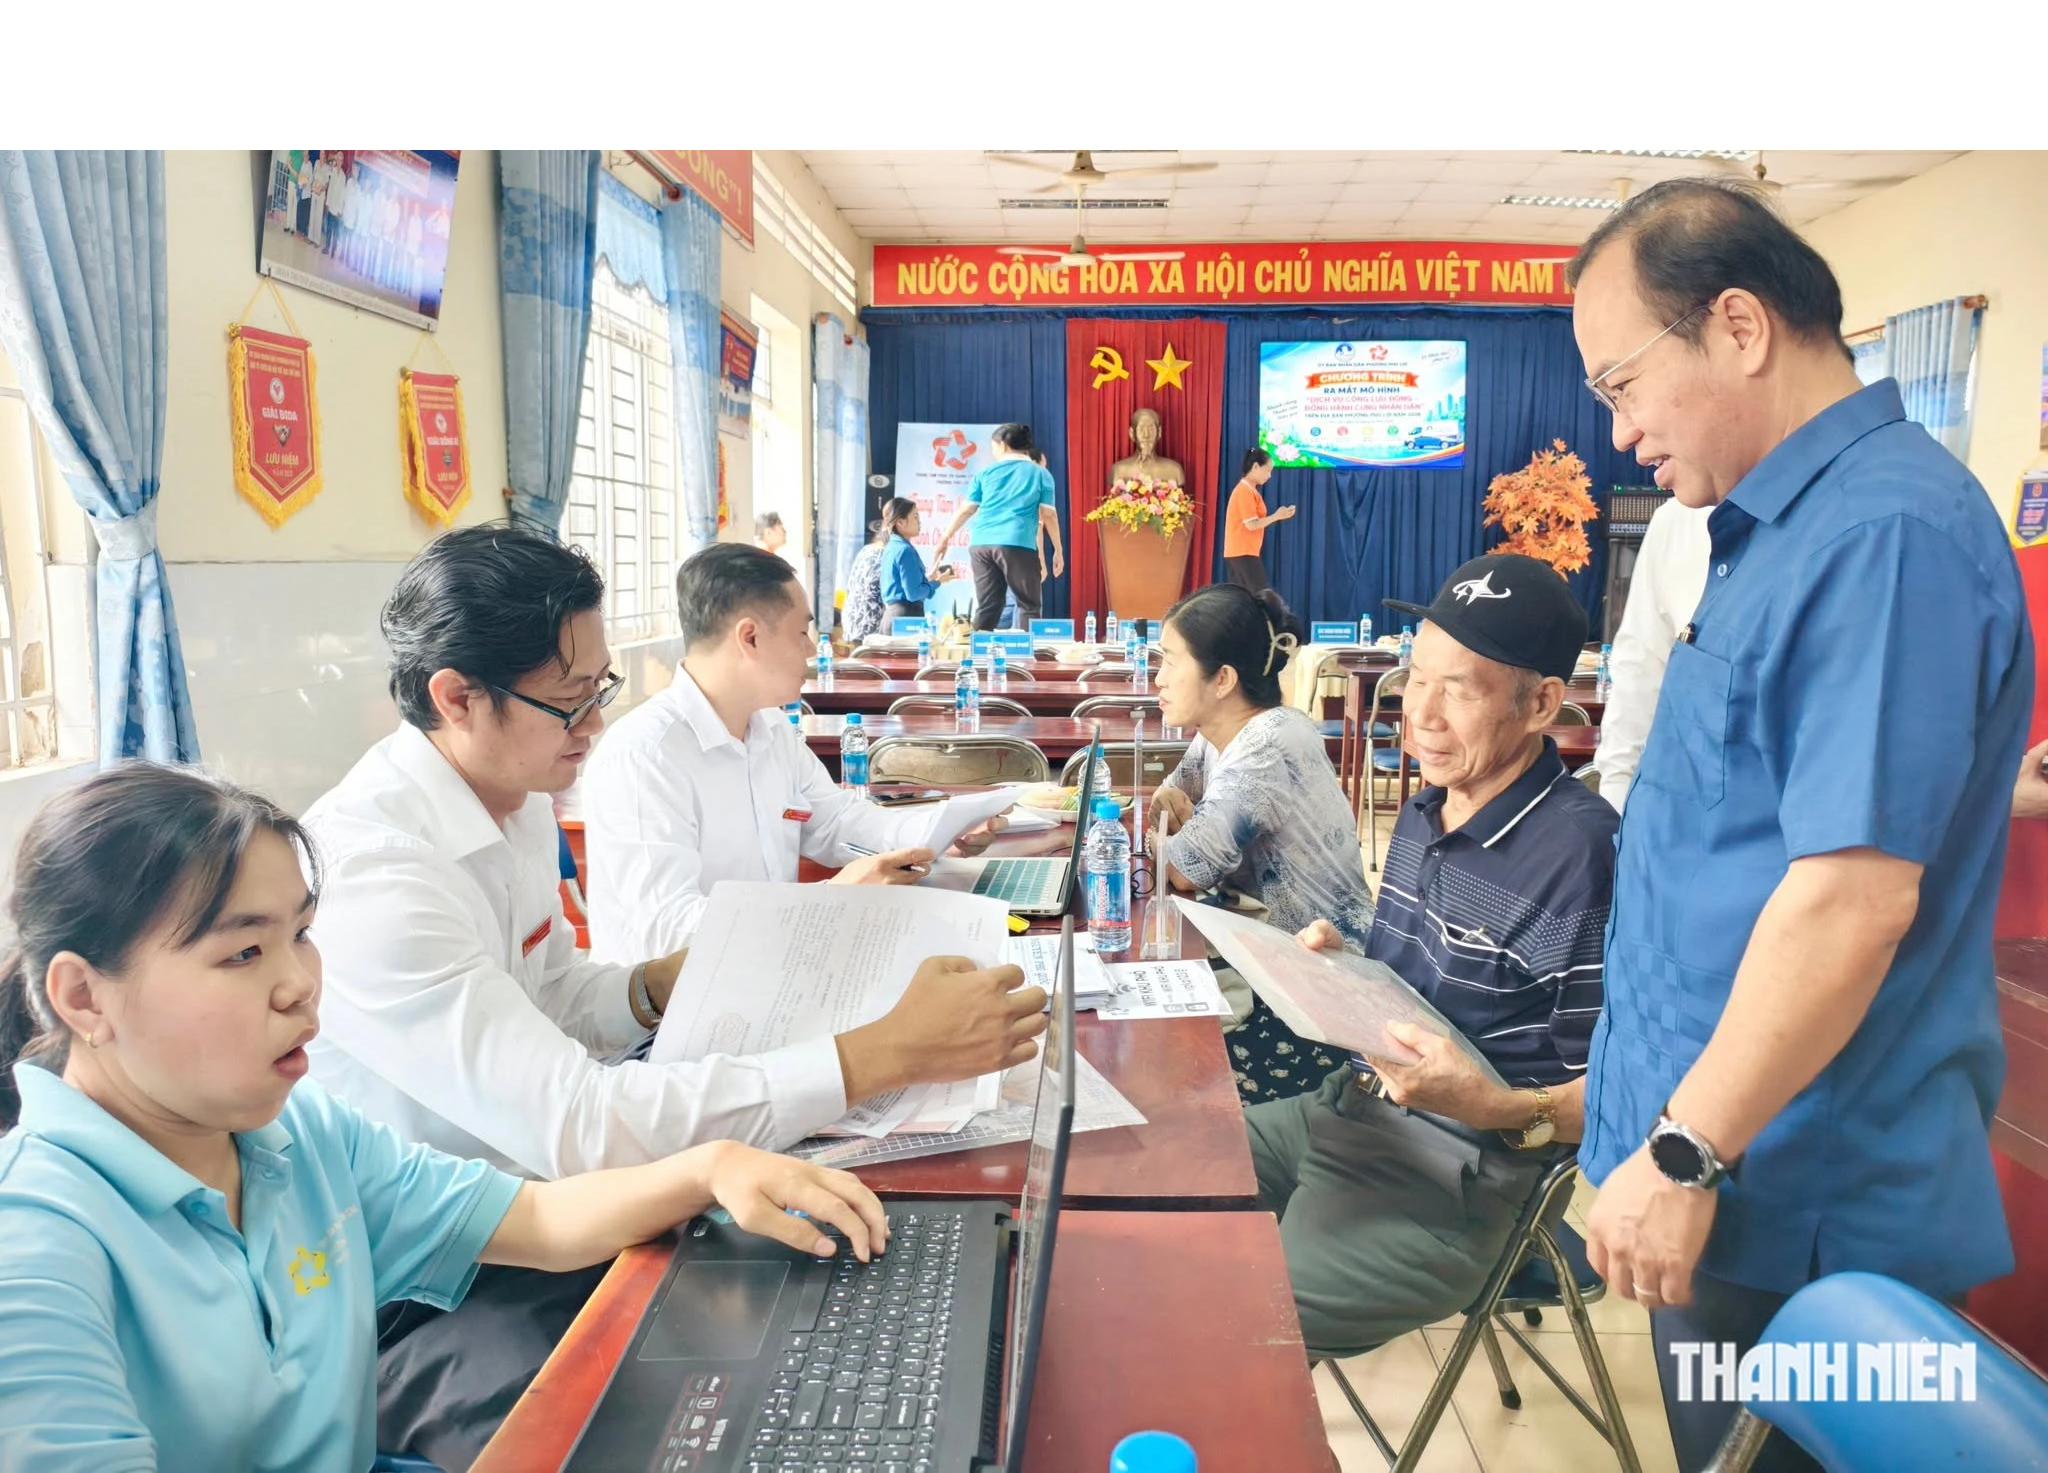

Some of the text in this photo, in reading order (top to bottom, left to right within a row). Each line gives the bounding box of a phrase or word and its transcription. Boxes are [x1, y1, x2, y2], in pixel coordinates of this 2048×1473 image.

[898, 254, 979, 295] NƯỚC
[988, 253, 1069, 301] CỘNG
[1196, 251, 1245, 300] HỘI
[1254, 247, 1312, 294] CHỦ
[1323, 250, 1408, 293] NGHĨA
[1416, 251, 1481, 299] VIỆT
[1491, 260, 1554, 294] NAM
[1320, 370, 1406, 384] CHƯƠNG TRÌNH
[1360, 386, 1375, 394] MÔ
[1138, 982, 1154, 994] KHU
[1140, 994, 1158, 1007] WIFI
